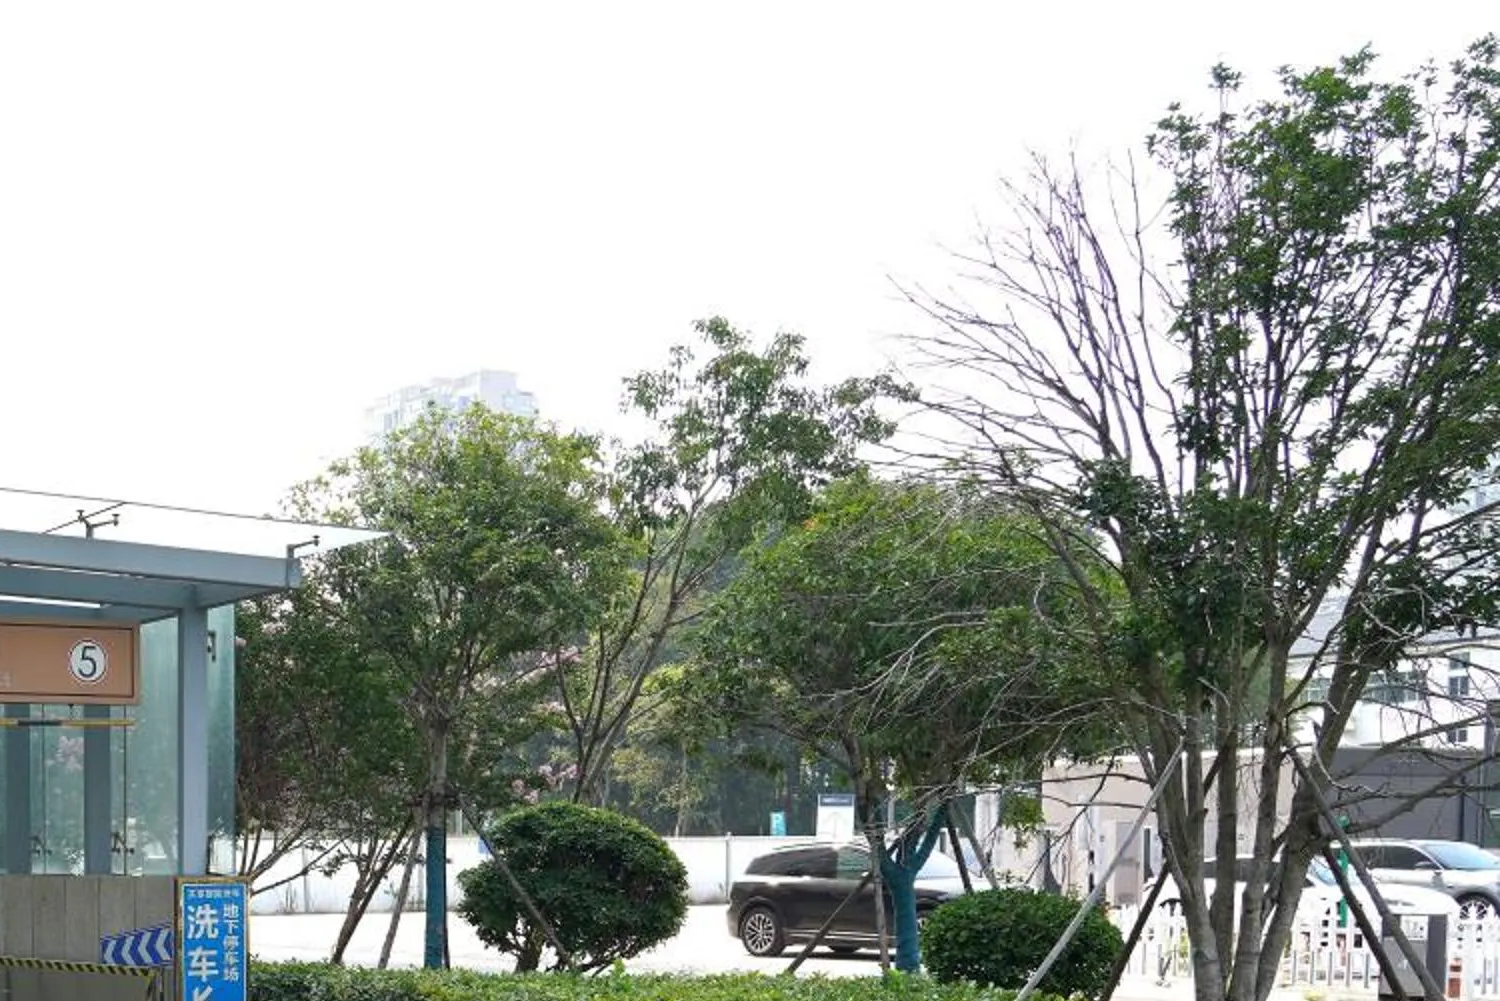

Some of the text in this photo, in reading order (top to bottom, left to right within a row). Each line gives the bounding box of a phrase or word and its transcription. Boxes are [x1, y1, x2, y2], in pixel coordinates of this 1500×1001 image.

[77, 645, 97, 678] 5
[187, 903, 219, 982] 洗车
[222, 903, 239, 982] 地下停车场
